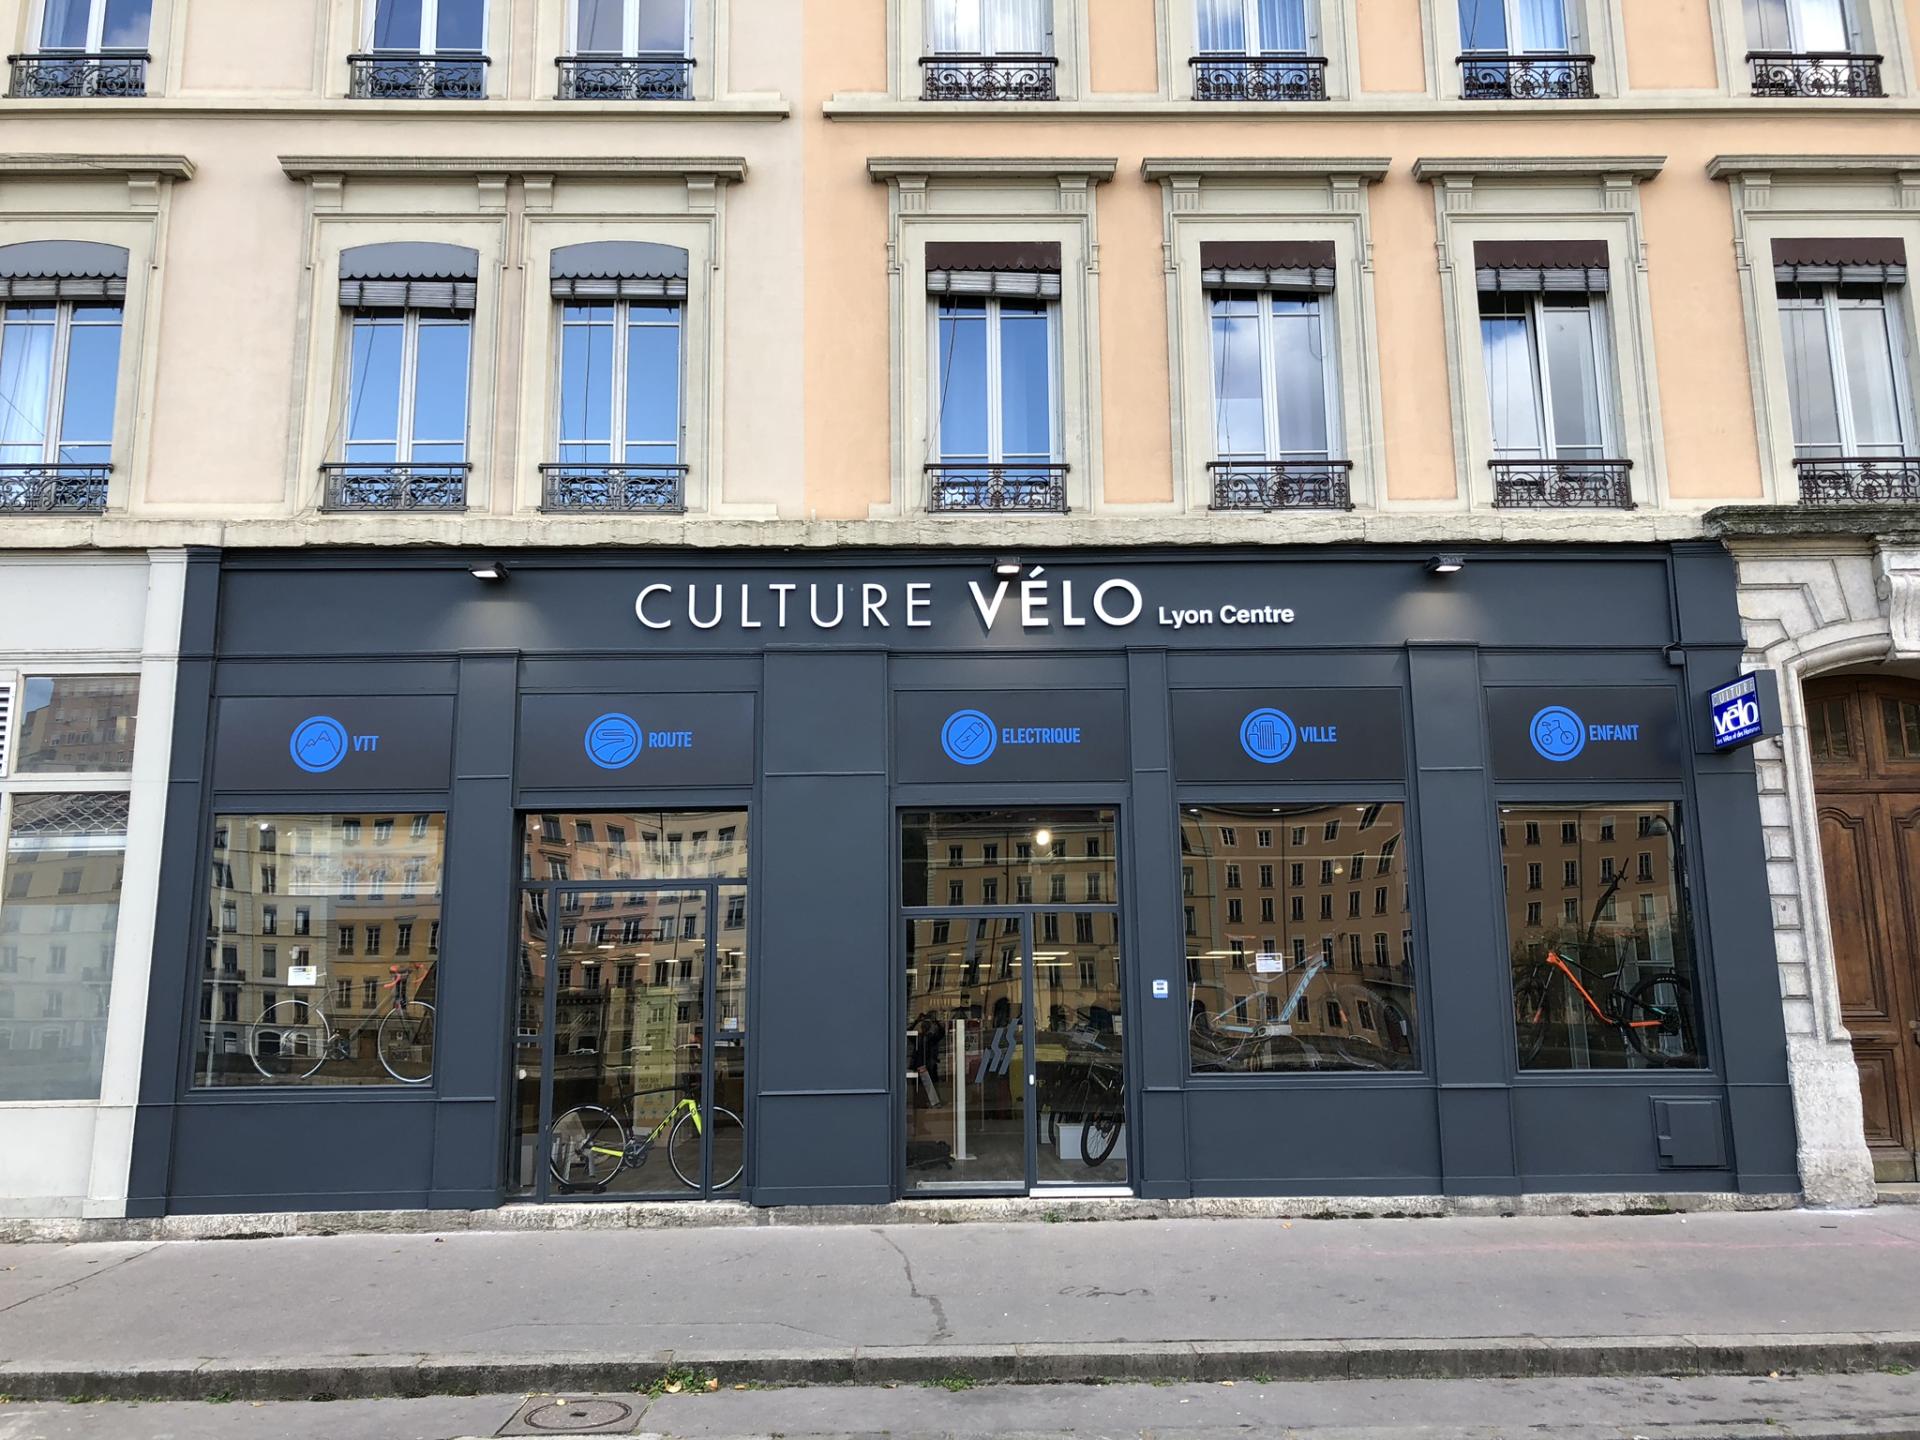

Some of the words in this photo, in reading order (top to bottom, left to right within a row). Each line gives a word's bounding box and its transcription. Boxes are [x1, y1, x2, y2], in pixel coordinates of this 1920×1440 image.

[634, 582, 932, 629] CULTURE
[968, 565, 1143, 630] VÉLO
[1157, 606, 1214, 629] Lyon
[1218, 604, 1296, 624] Centre
[352, 734, 379, 752] VTT
[647, 730, 694, 750] ROUTE
[1000, 726, 1082, 746] ELECTRIQUE
[1298, 725, 1338, 744] VILLE
[1588, 724, 1640, 743] ENFANT
